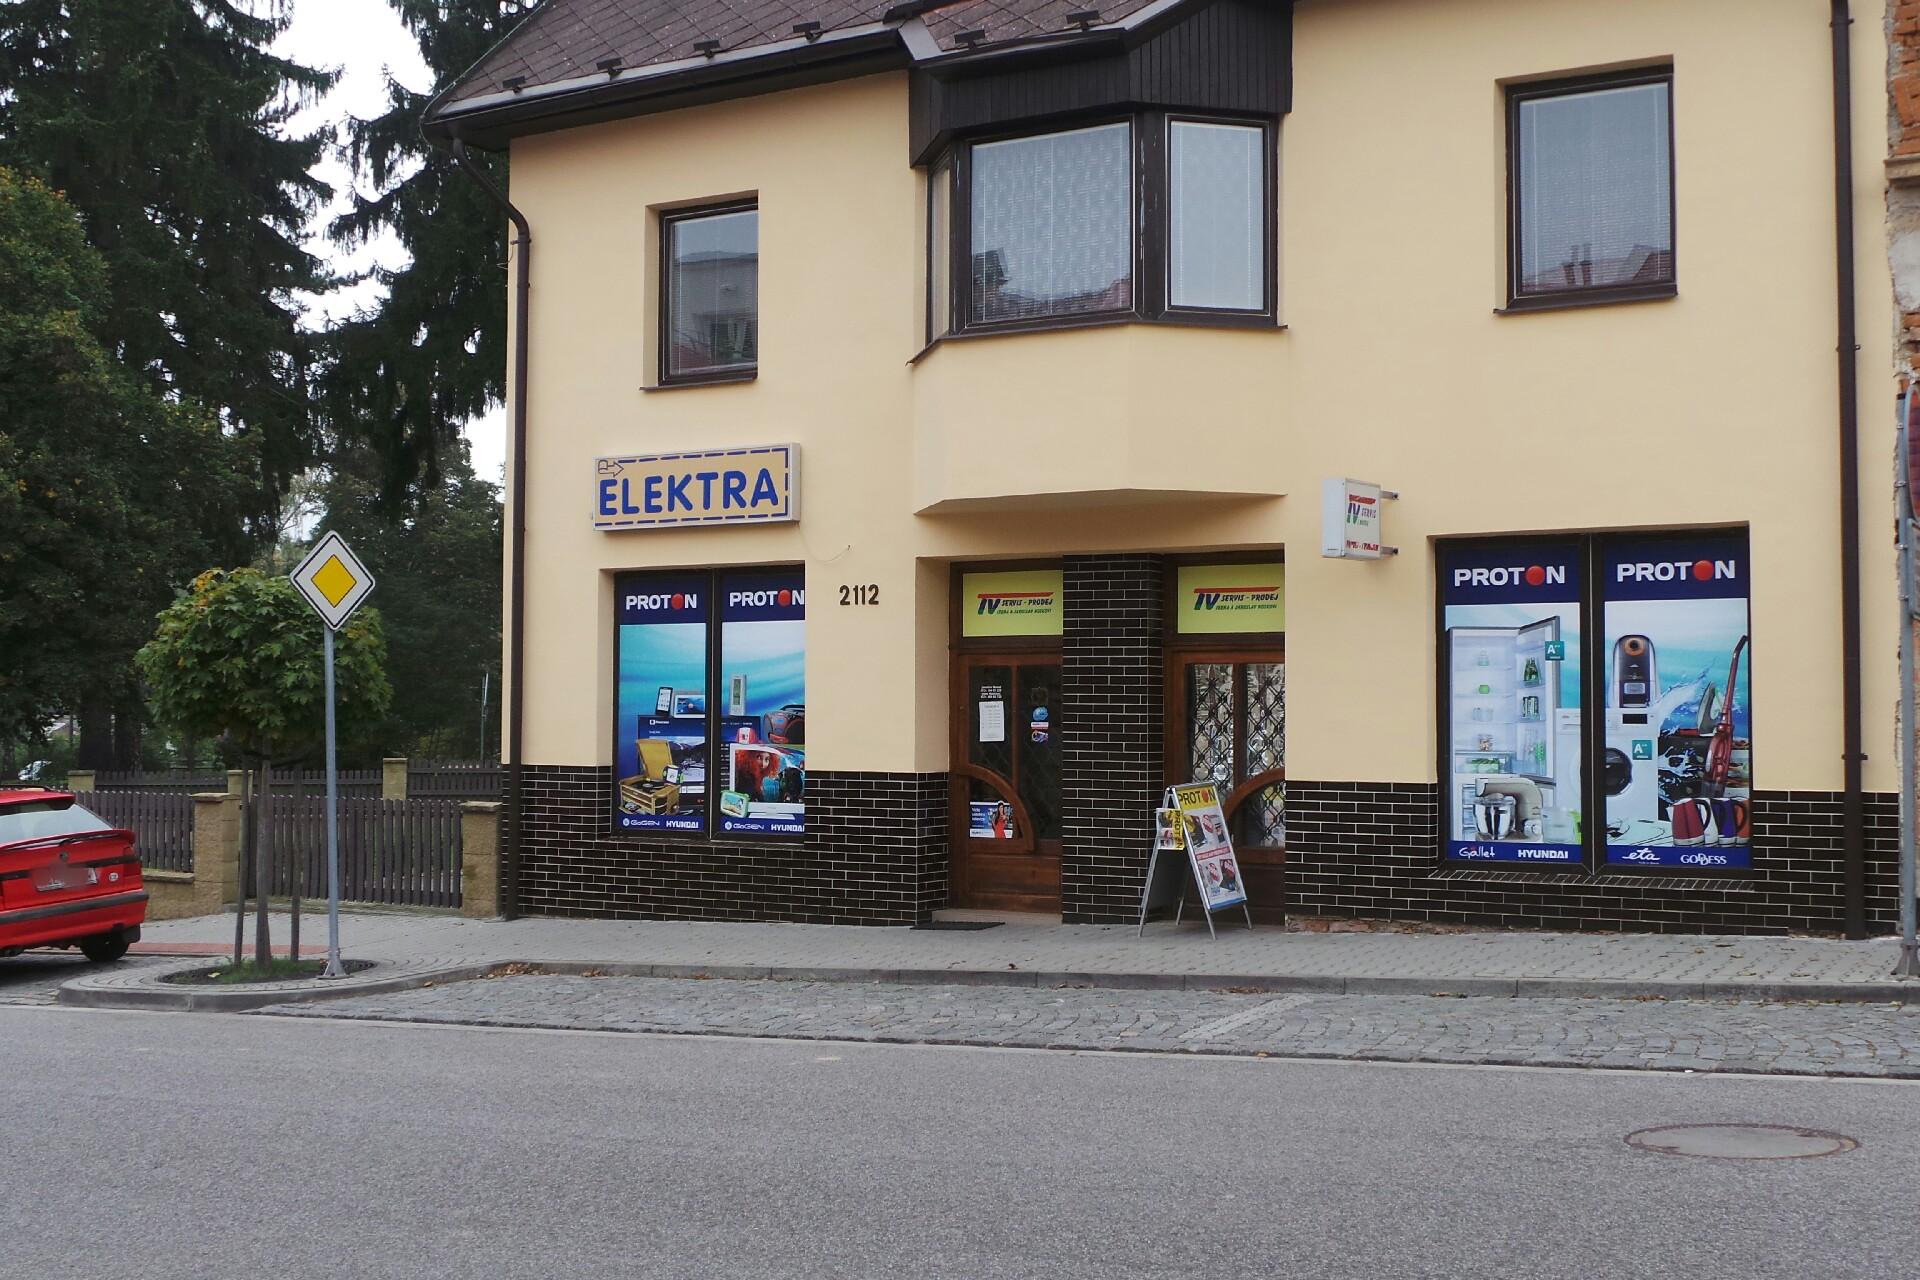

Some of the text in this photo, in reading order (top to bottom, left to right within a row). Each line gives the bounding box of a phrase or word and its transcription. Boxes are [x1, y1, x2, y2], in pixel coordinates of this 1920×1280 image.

[600, 468, 779, 516] ELEKTRA
[1454, 565, 1565, 587] PROTON
[1616, 560, 1736, 583] PROTON
[625, 593, 697, 610] PROTON
[729, 589, 805, 608] PROTON
[839, 584, 880, 606] 2112
[1001, 599, 1023, 607] SERVIS
[1027, 598, 1054, 607] PRODEJ
[1221, 594, 1245, 602] SERVIS
[1251, 593, 1279, 602] PRODEJ
[1177, 787, 1216, 806] PROTON
[666, 820, 699, 829] HYUNDAI
[771, 824, 805, 832] HYUNDAI
[1458, 846, 1568, 859] Gallet HYUNDAI
[1622, 847, 1727, 866] eta GODDESS
